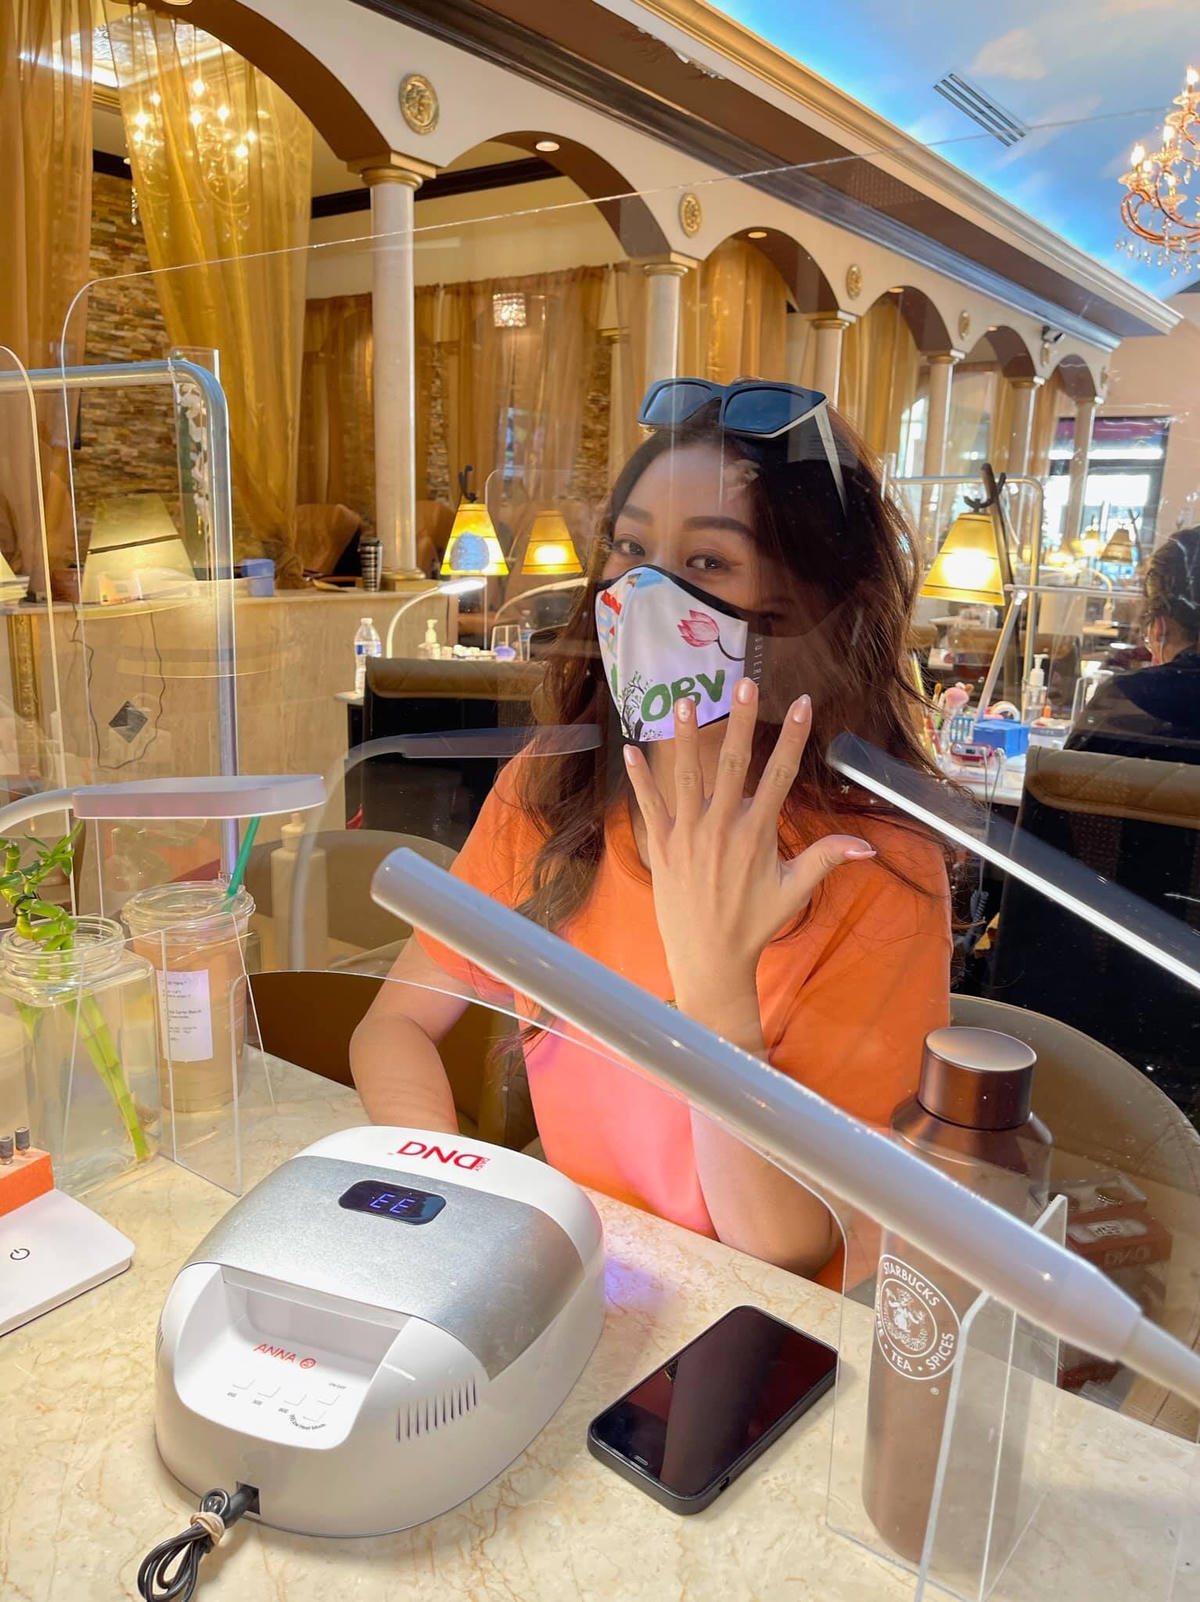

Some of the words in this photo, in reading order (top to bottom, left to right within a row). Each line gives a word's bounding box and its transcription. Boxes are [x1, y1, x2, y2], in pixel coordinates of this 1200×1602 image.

[397, 1141, 484, 1170] DND
[883, 1262, 940, 1307] STARBUCKS
[253, 1343, 297, 1363] ANNA
[891, 1351, 913, 1372] TEA
[926, 1333, 955, 1371] SPICES
